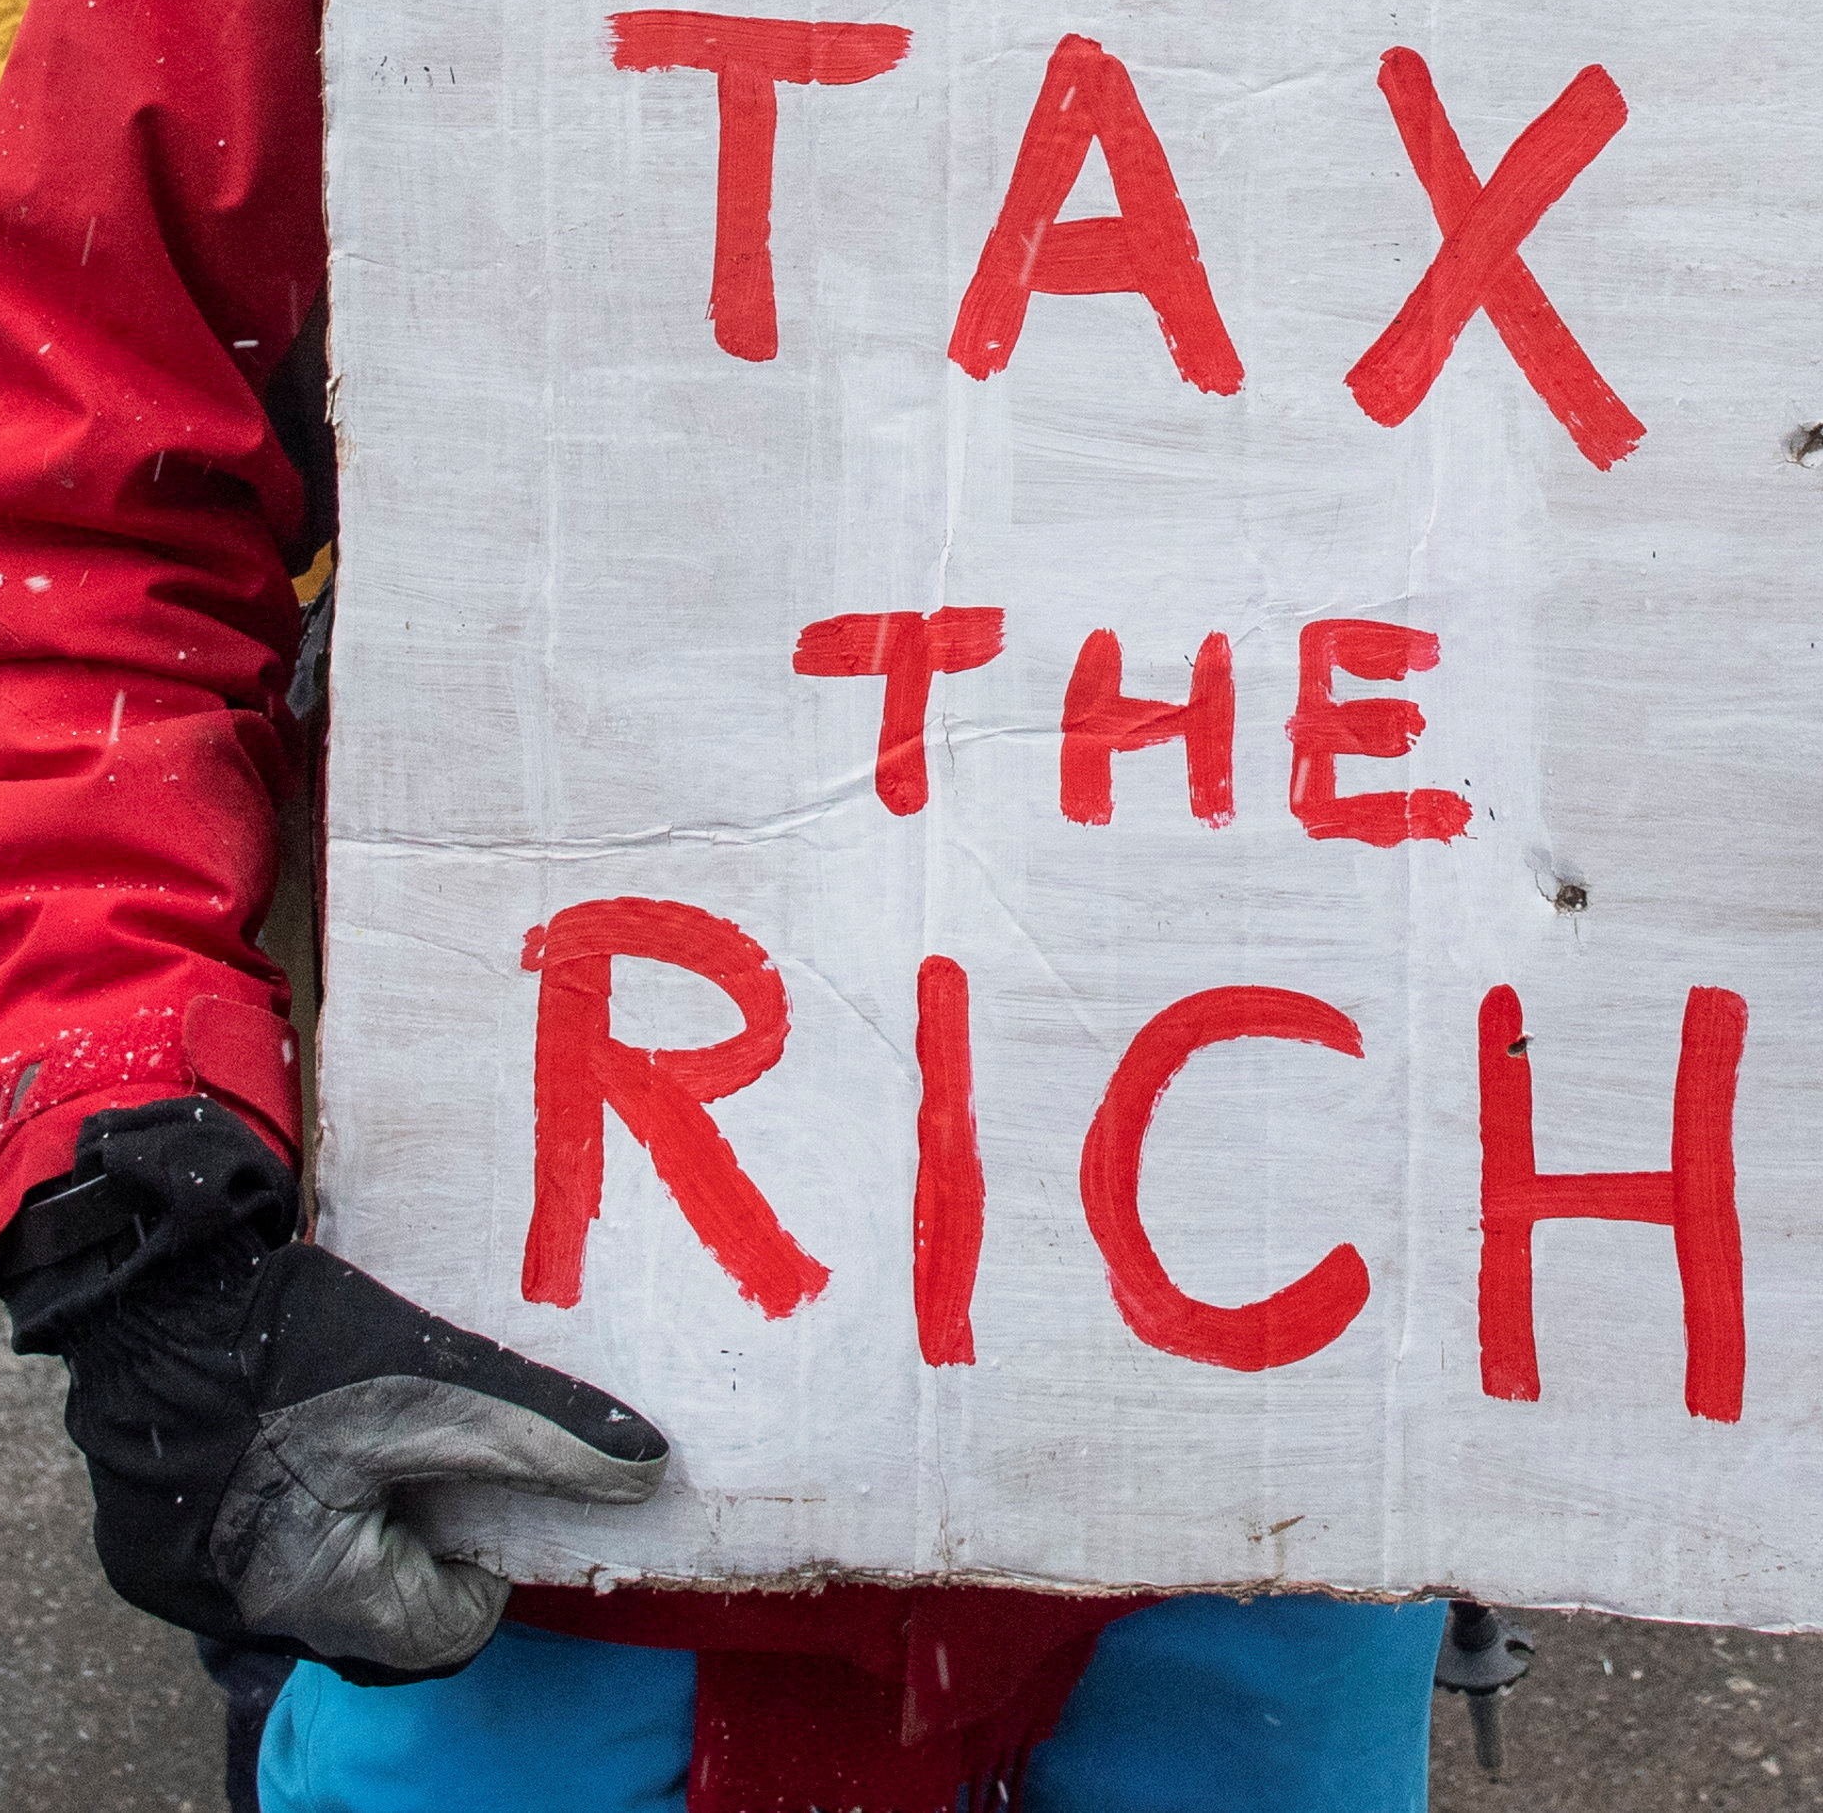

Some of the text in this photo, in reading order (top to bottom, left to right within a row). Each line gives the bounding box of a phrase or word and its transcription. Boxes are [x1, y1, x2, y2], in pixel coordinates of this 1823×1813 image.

[608, 7, 1647, 472] TAX
[791, 604, 1473, 849] THE
[519, 894, 1749, 1425] RICH
